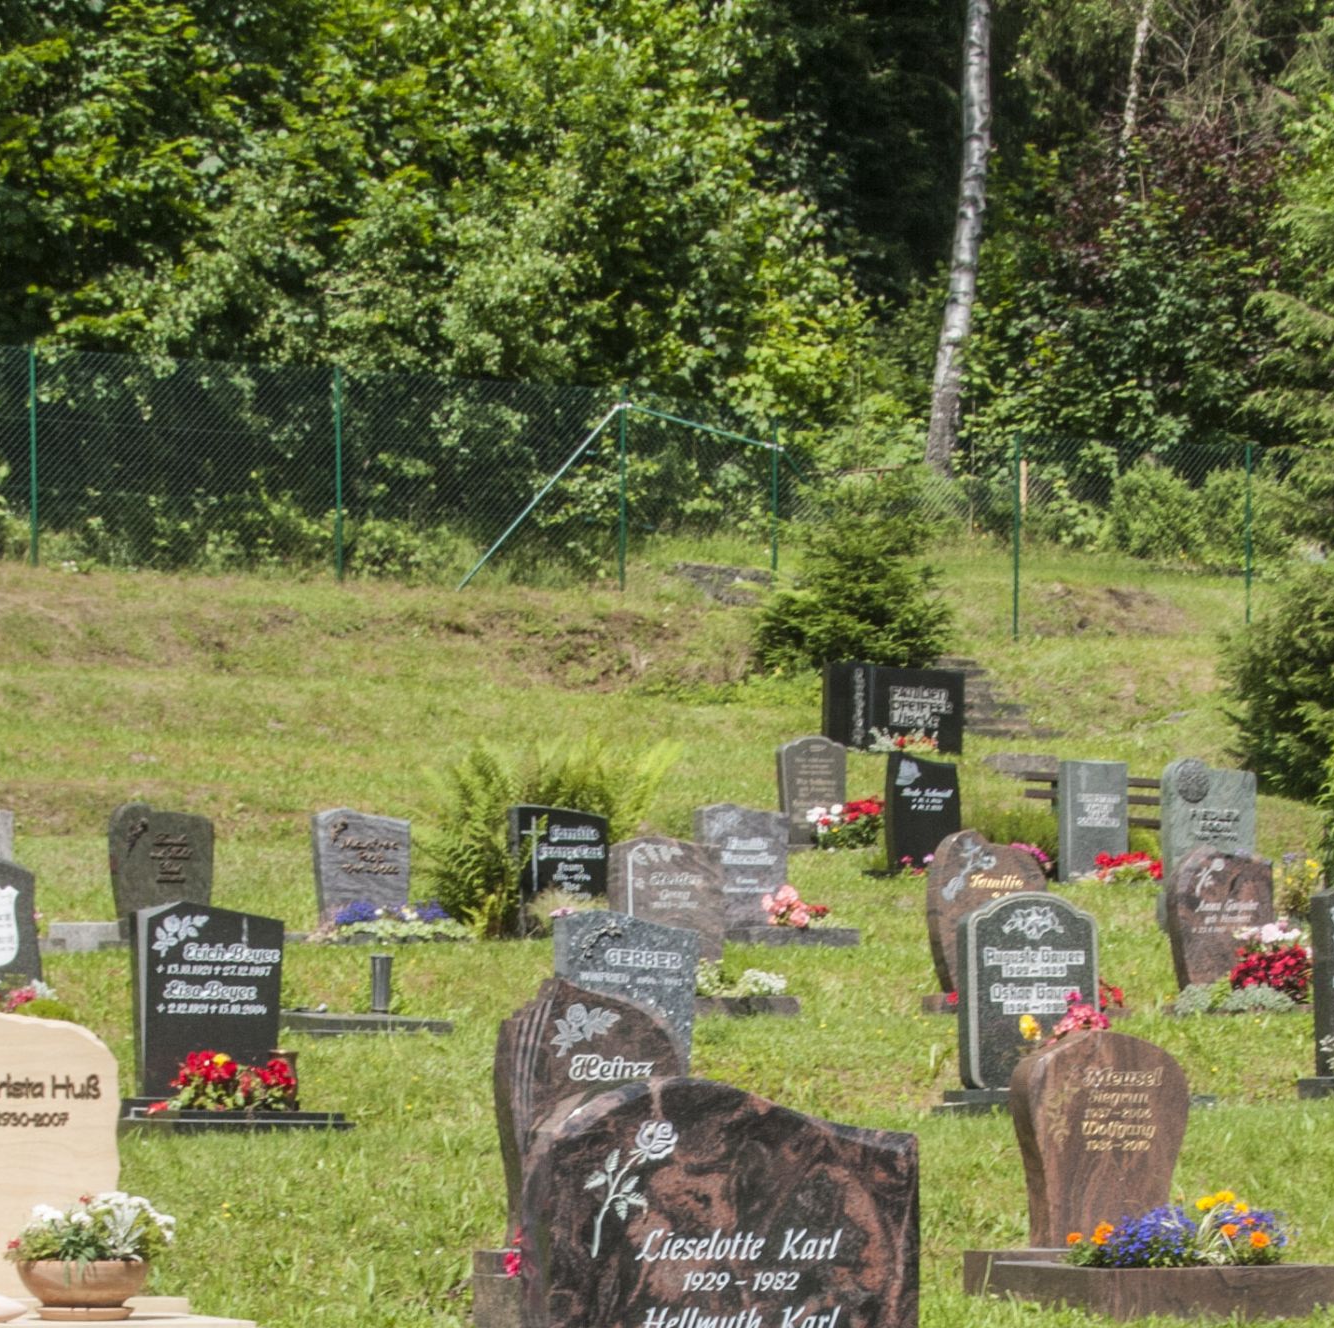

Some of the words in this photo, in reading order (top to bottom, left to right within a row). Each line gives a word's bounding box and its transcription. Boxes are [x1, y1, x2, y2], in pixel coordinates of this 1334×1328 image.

[183, 942, 228, 961] Erich
[227, 943, 281, 964] Beyer
[604, 948, 682, 969] GERBER
[163, 980, 204, 999] Lisa
[203, 980, 258, 1003] Beyer
[569, 1054, 655, 1081] Heinz
[1082, 1066, 1163, 1088] Meusel
[51, 1074, 101, 1100] Huß
[1081, 1121, 1157, 1139] Wolfgang
[635, 1228, 765, 1261] Lieselotte
[778, 1228, 843, 1260] Karl
[682, 1272, 730, 1291] 1929
[752, 1271, 800, 1291] 1982
